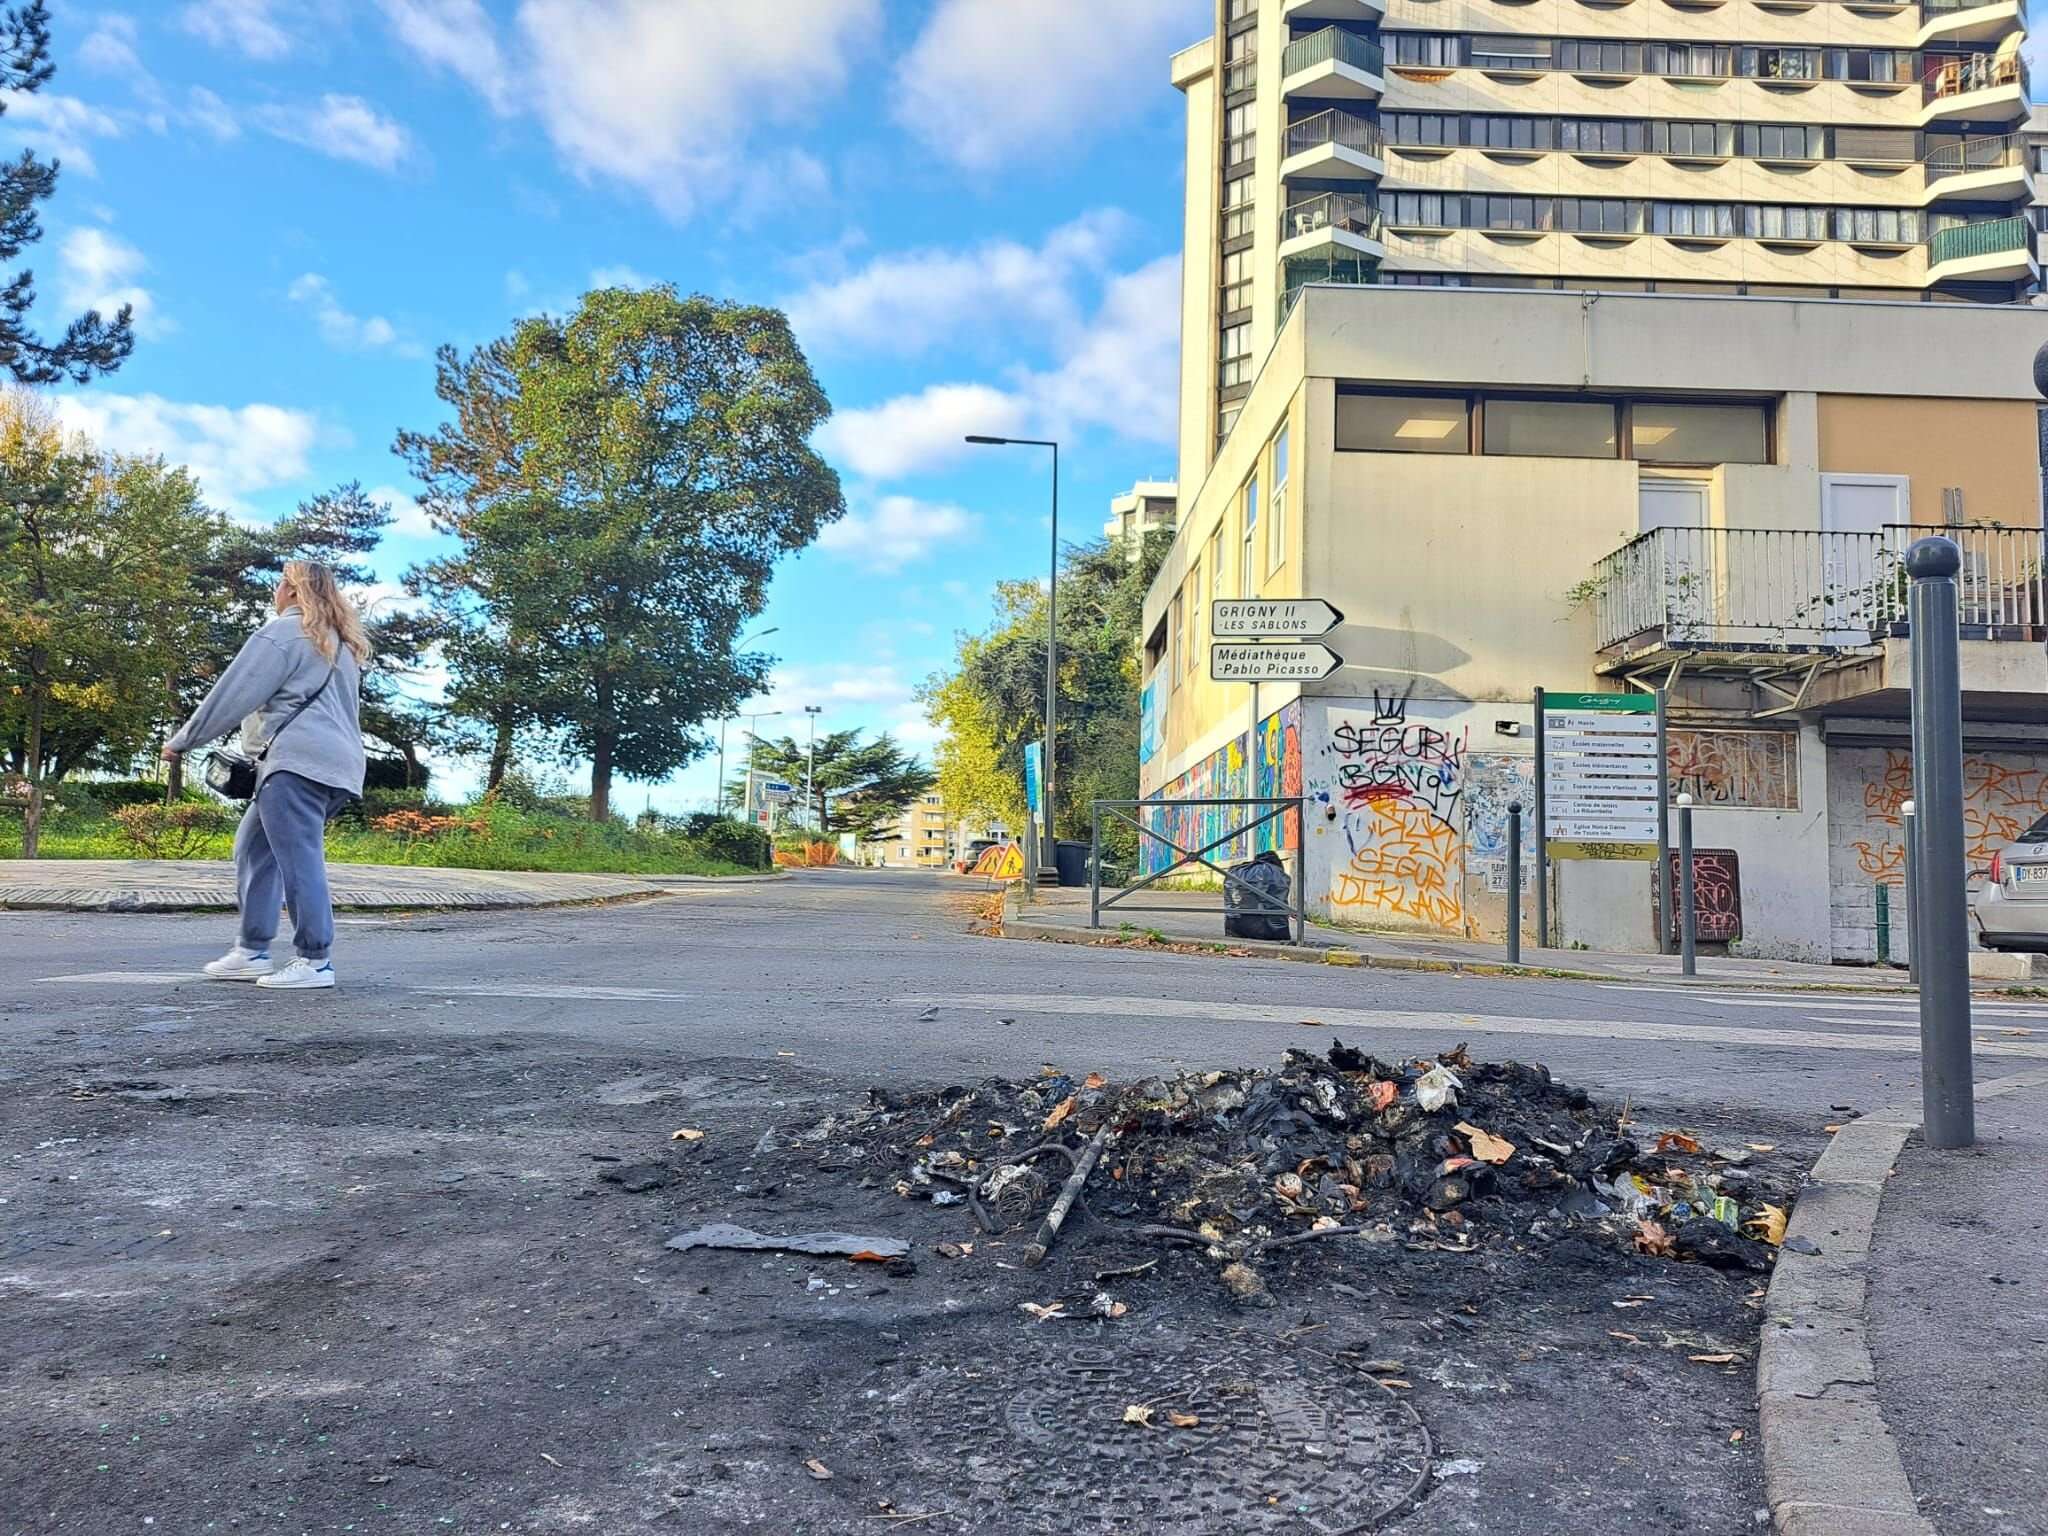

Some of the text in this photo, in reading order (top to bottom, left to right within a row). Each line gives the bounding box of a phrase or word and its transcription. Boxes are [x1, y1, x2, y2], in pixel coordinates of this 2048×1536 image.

[1219, 605, 1296, 617] GRIGNY II
[1251, 620, 1307, 630] SABLONS
[1217, 649, 1306, 662] Médiathèque
[1266, 663, 1319, 675] Picasso
